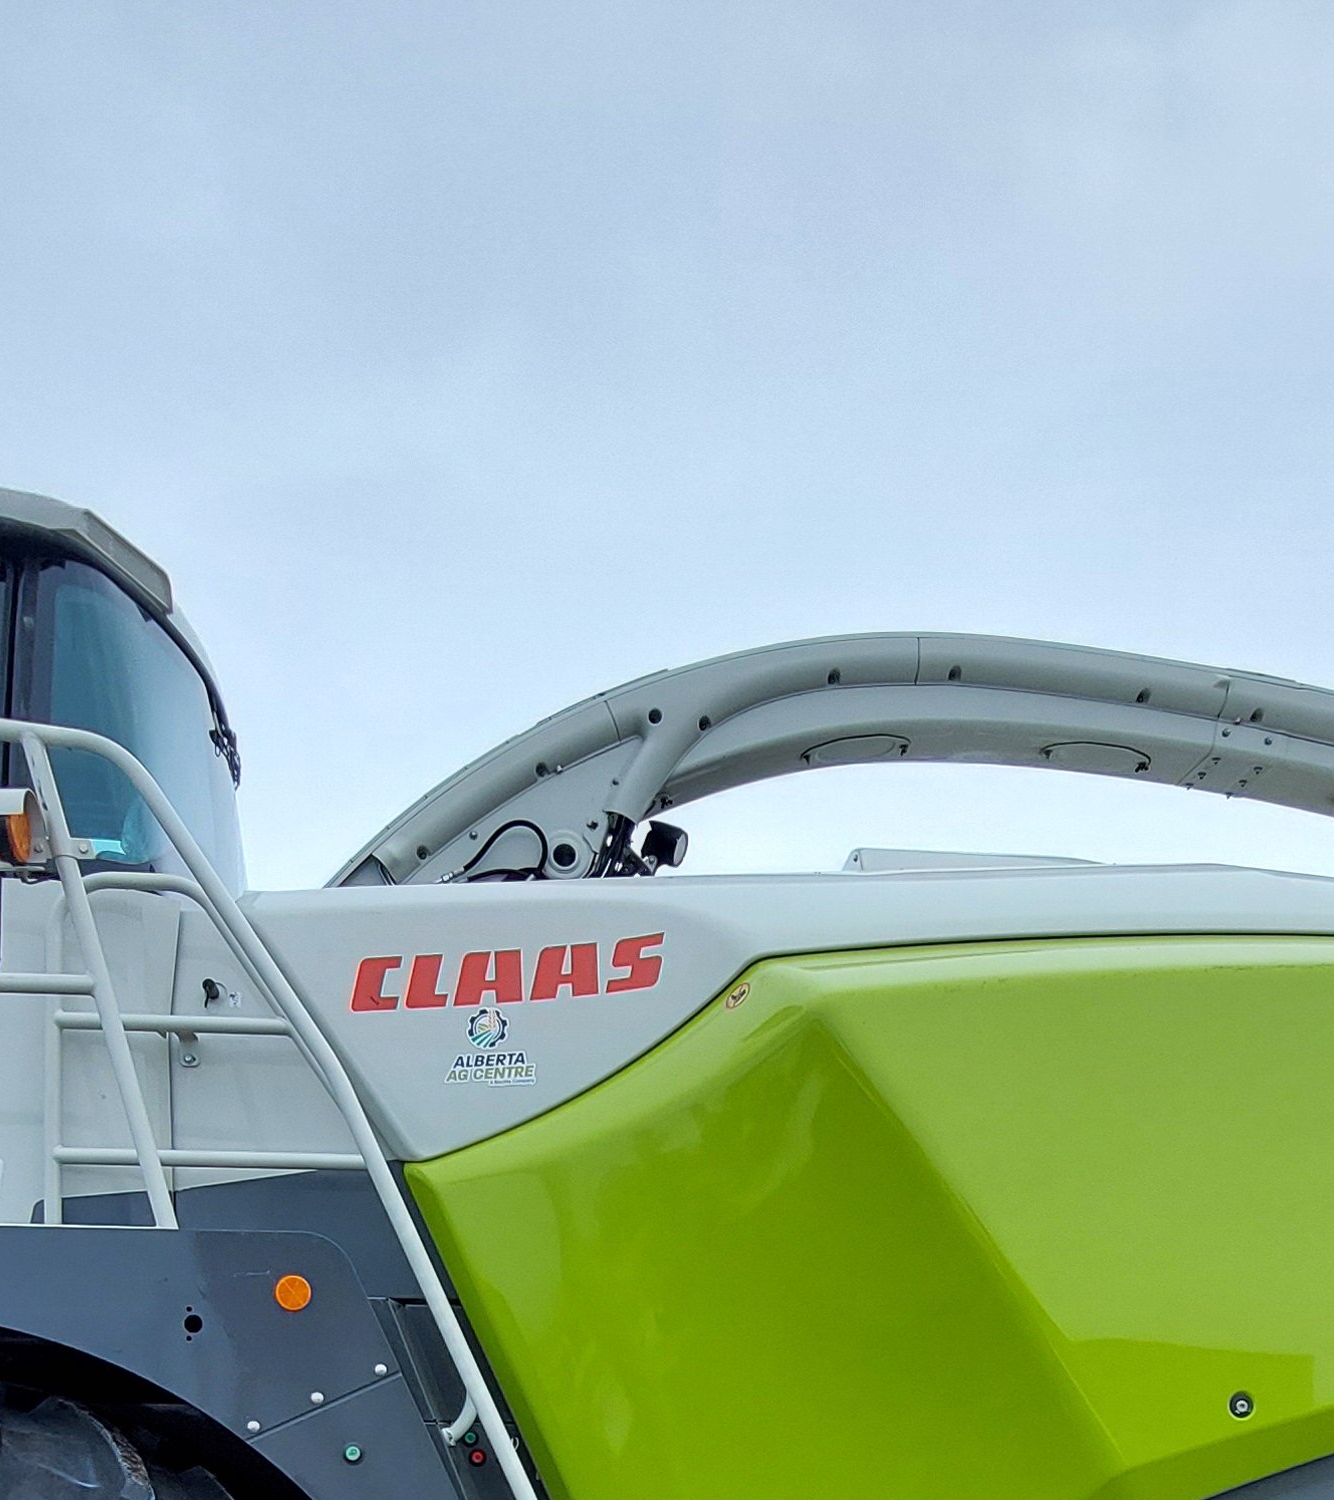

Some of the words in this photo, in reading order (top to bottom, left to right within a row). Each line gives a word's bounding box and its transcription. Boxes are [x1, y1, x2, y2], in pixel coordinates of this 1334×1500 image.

[350, 932, 665, 1013] CLAAS
[453, 1052, 526, 1068] ALBERTA
[446, 1068, 469, 1082] AG
[473, 1065, 534, 1081] CENTRE
